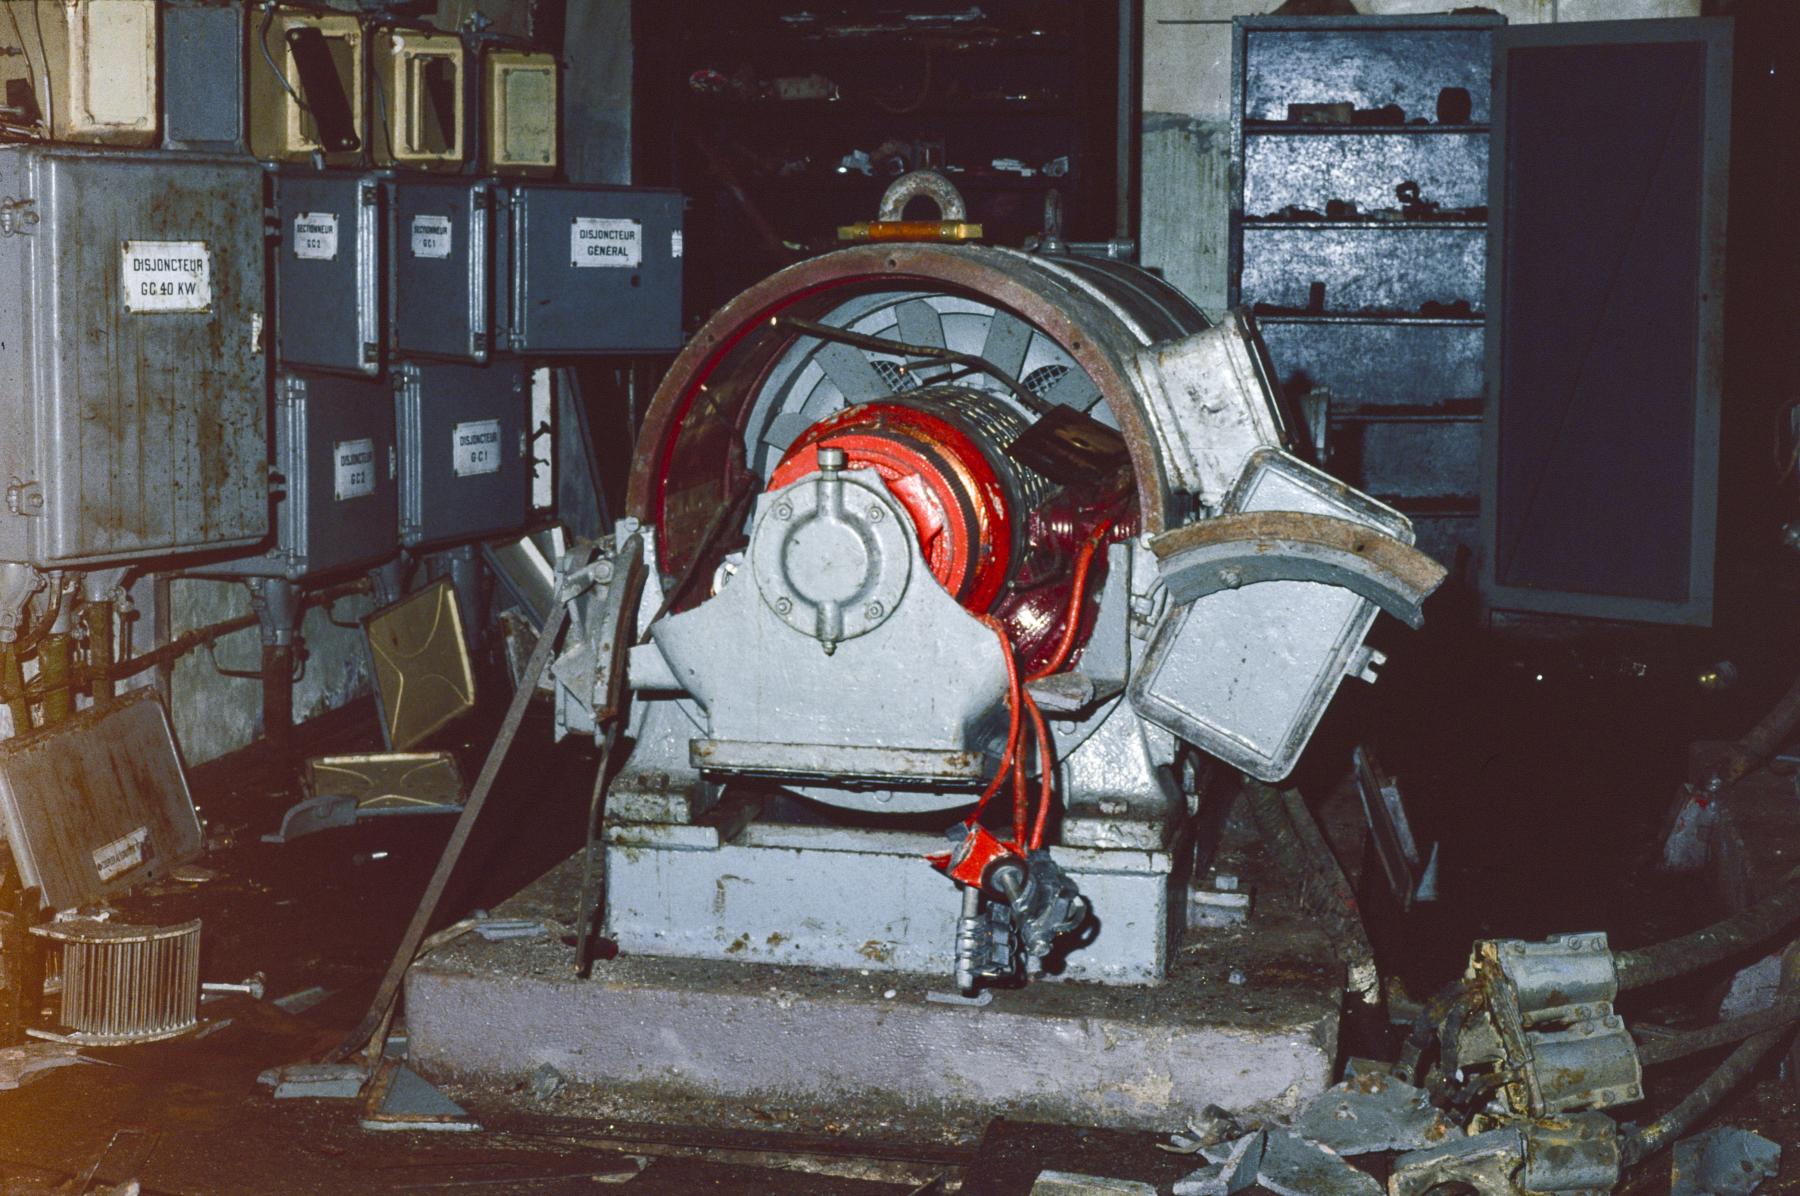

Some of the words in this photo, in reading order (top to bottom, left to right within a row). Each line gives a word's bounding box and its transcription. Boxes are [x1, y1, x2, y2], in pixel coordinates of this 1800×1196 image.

[580, 229, 635, 240] DISJONCTEUR
[133, 258, 203, 271] DISJONCTEUR
[141, 282, 156, 295] GC
[177, 282, 196, 295] KW
[460, 432, 497, 446] DISJONCTEUR
